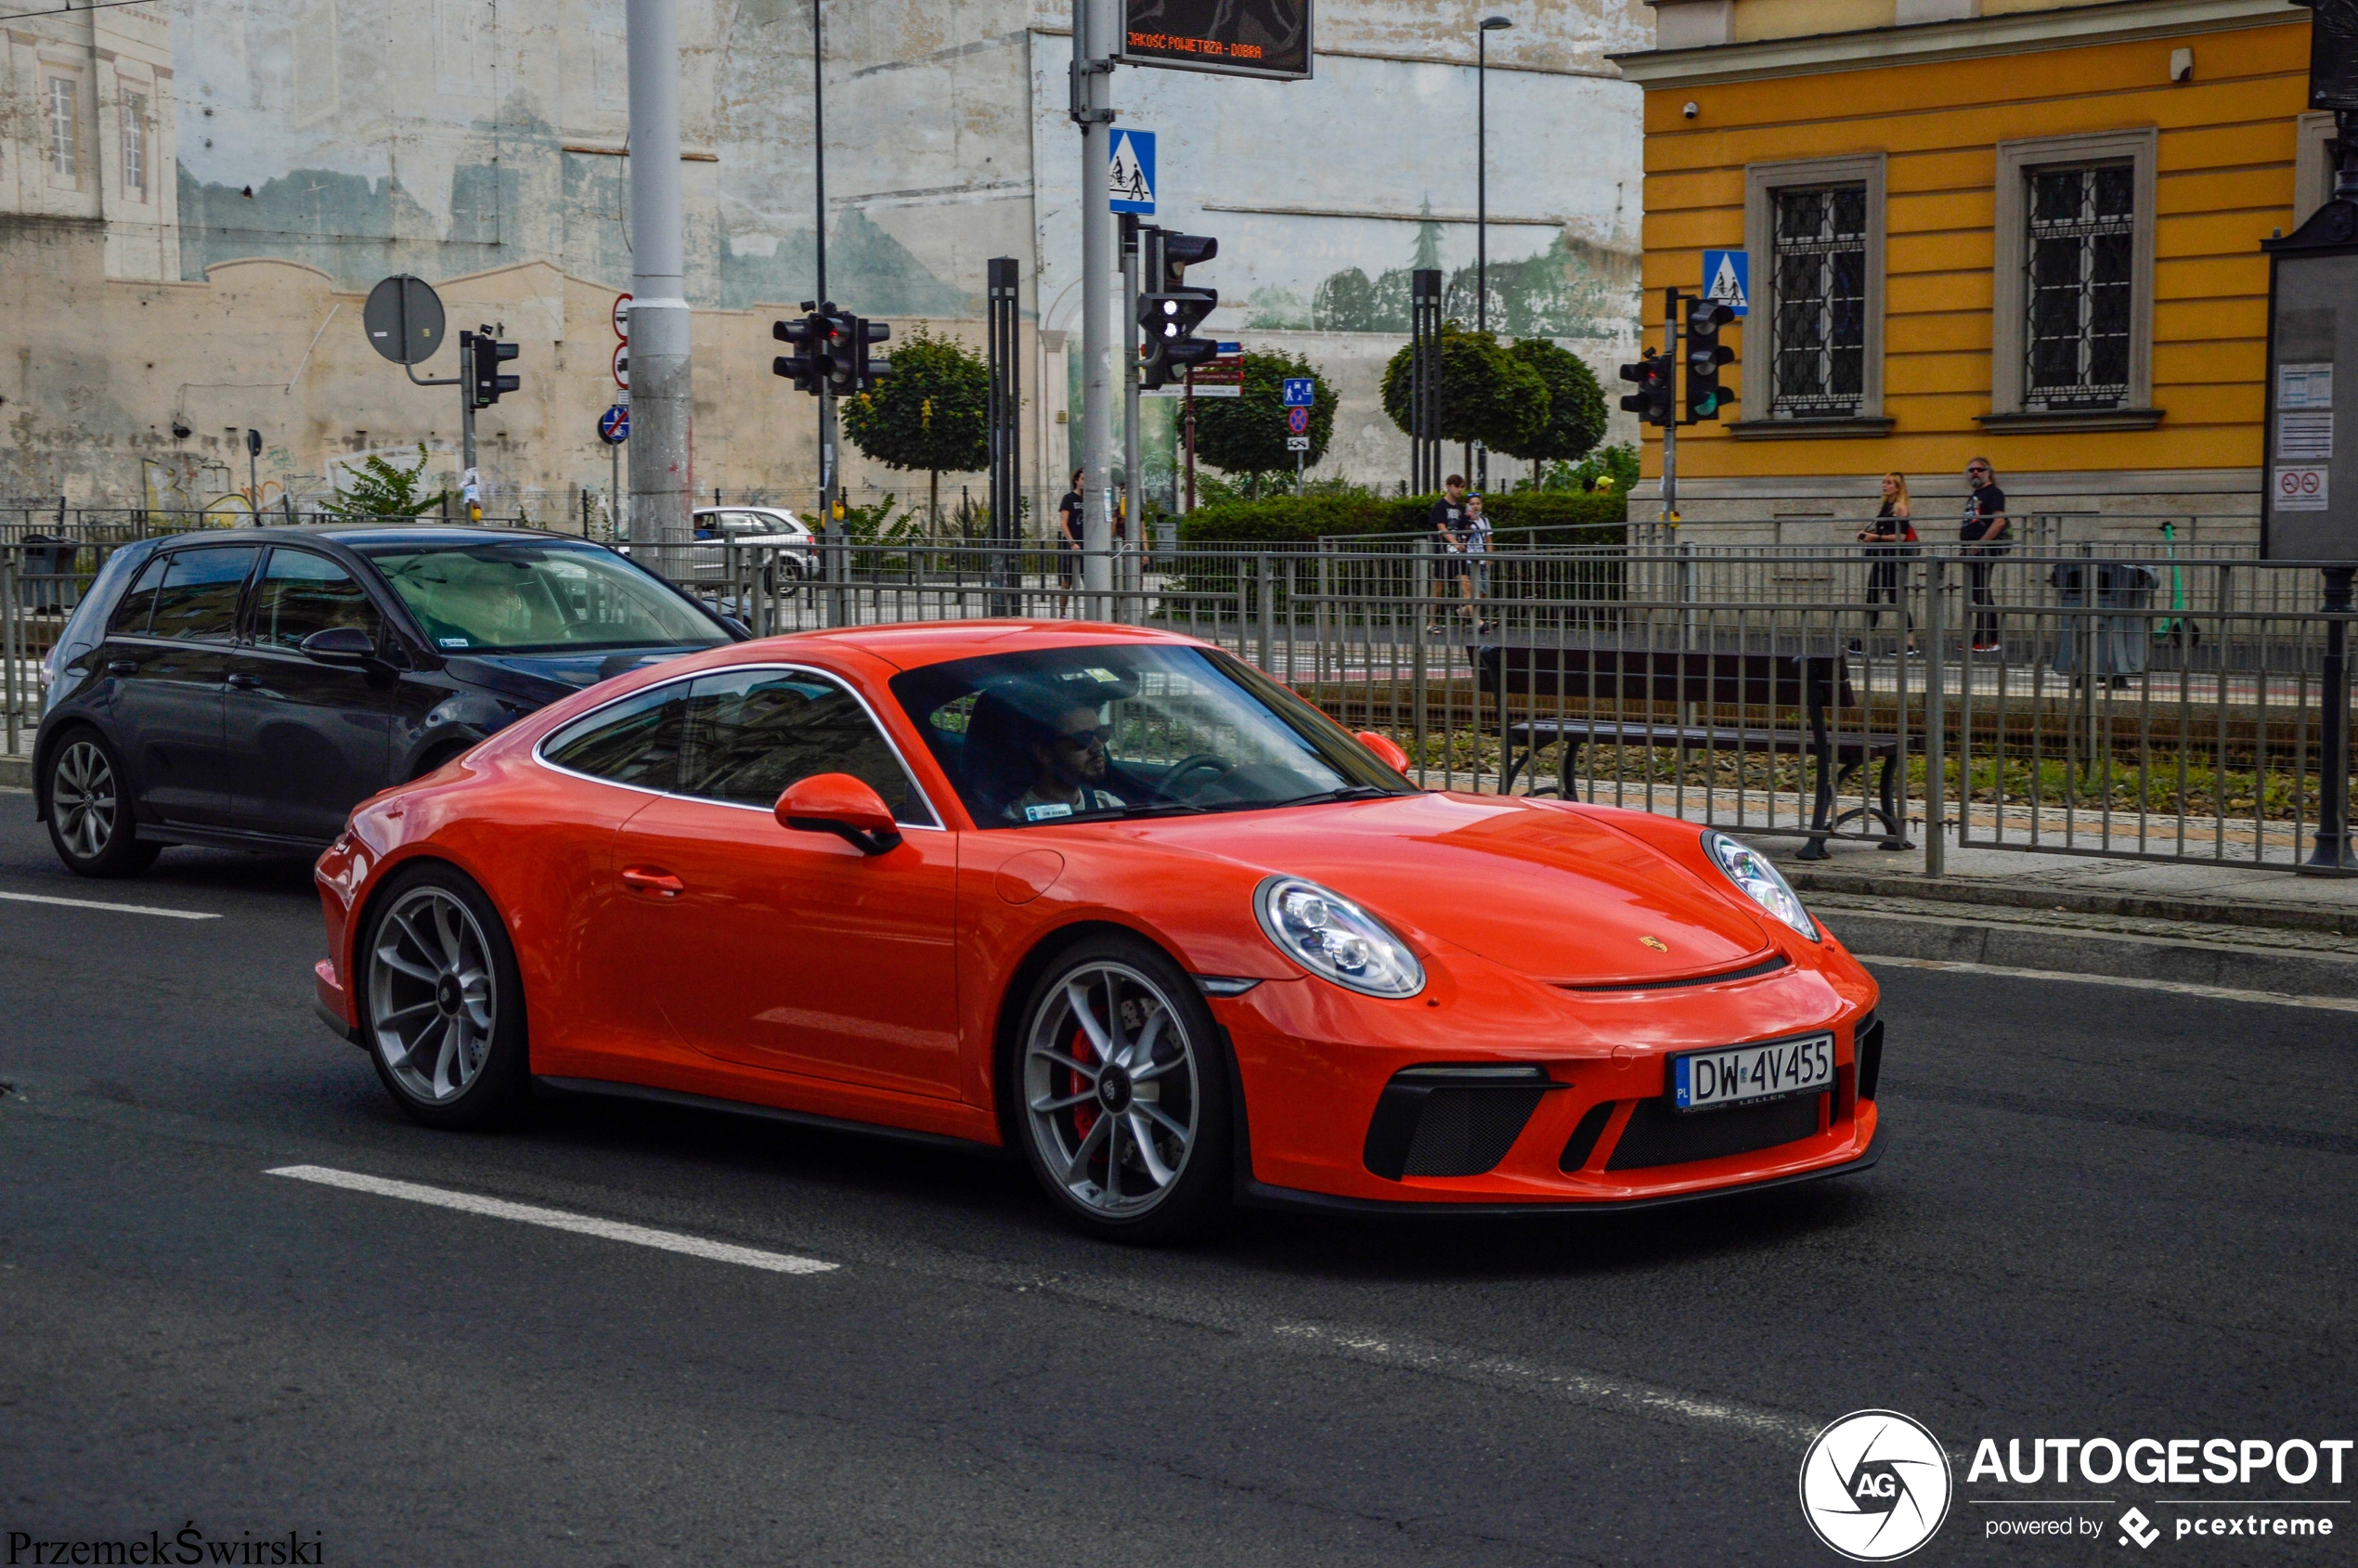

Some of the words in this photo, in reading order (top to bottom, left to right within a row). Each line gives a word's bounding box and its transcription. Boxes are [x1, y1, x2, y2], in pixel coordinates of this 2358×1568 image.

[1168, 36, 1223, 55] POWIETRZA
[1230, 43, 1262, 58] DOBRA
[1695, 1055, 1739, 1101] DW
[1750, 1040, 1828, 1091] 4V455
[1677, 1087, 1689, 1100] PL
[1682, 1102, 1728, 1114] PORSCHE
[1739, 1093, 1786, 1106] LELLEK
[1796, 1084, 1831, 1096] PORSCHE
